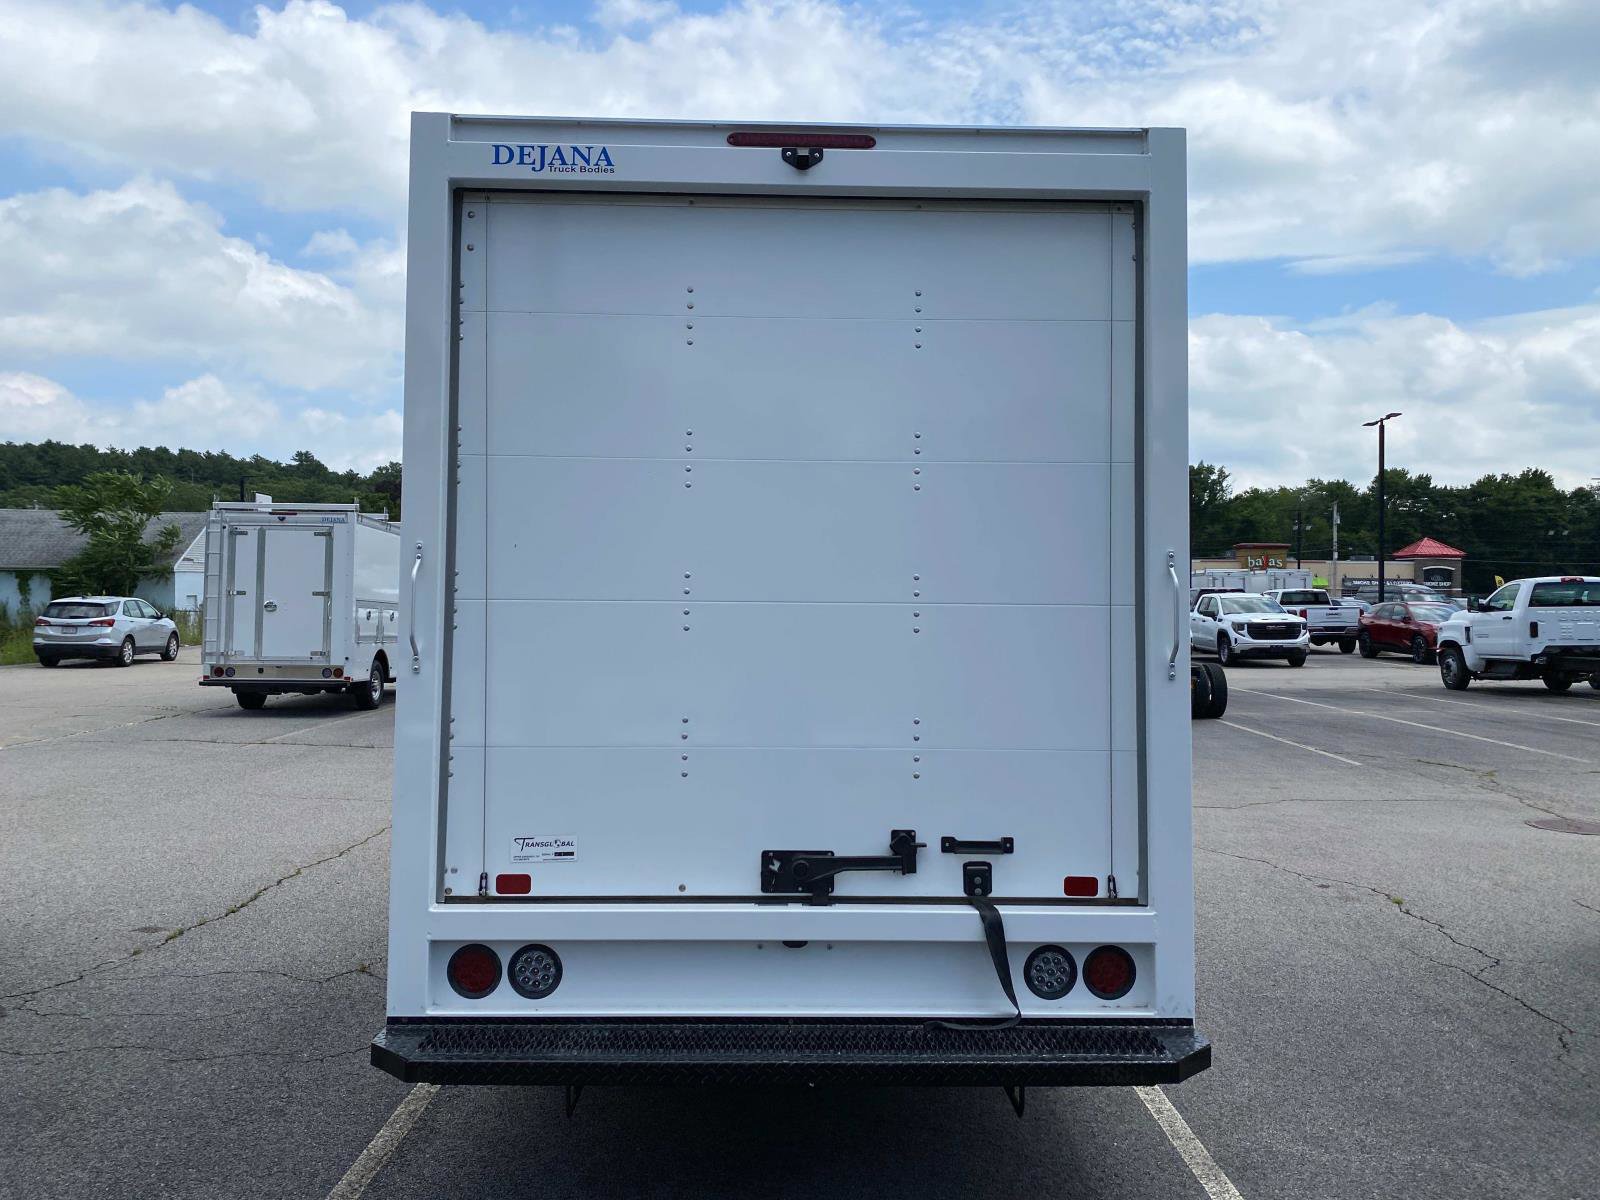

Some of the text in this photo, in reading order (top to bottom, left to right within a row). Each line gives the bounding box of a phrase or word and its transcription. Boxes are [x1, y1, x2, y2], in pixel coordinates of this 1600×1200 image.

[491, 144, 615, 172] DEJANA
[548, 165, 615, 174] Truck Bodies
